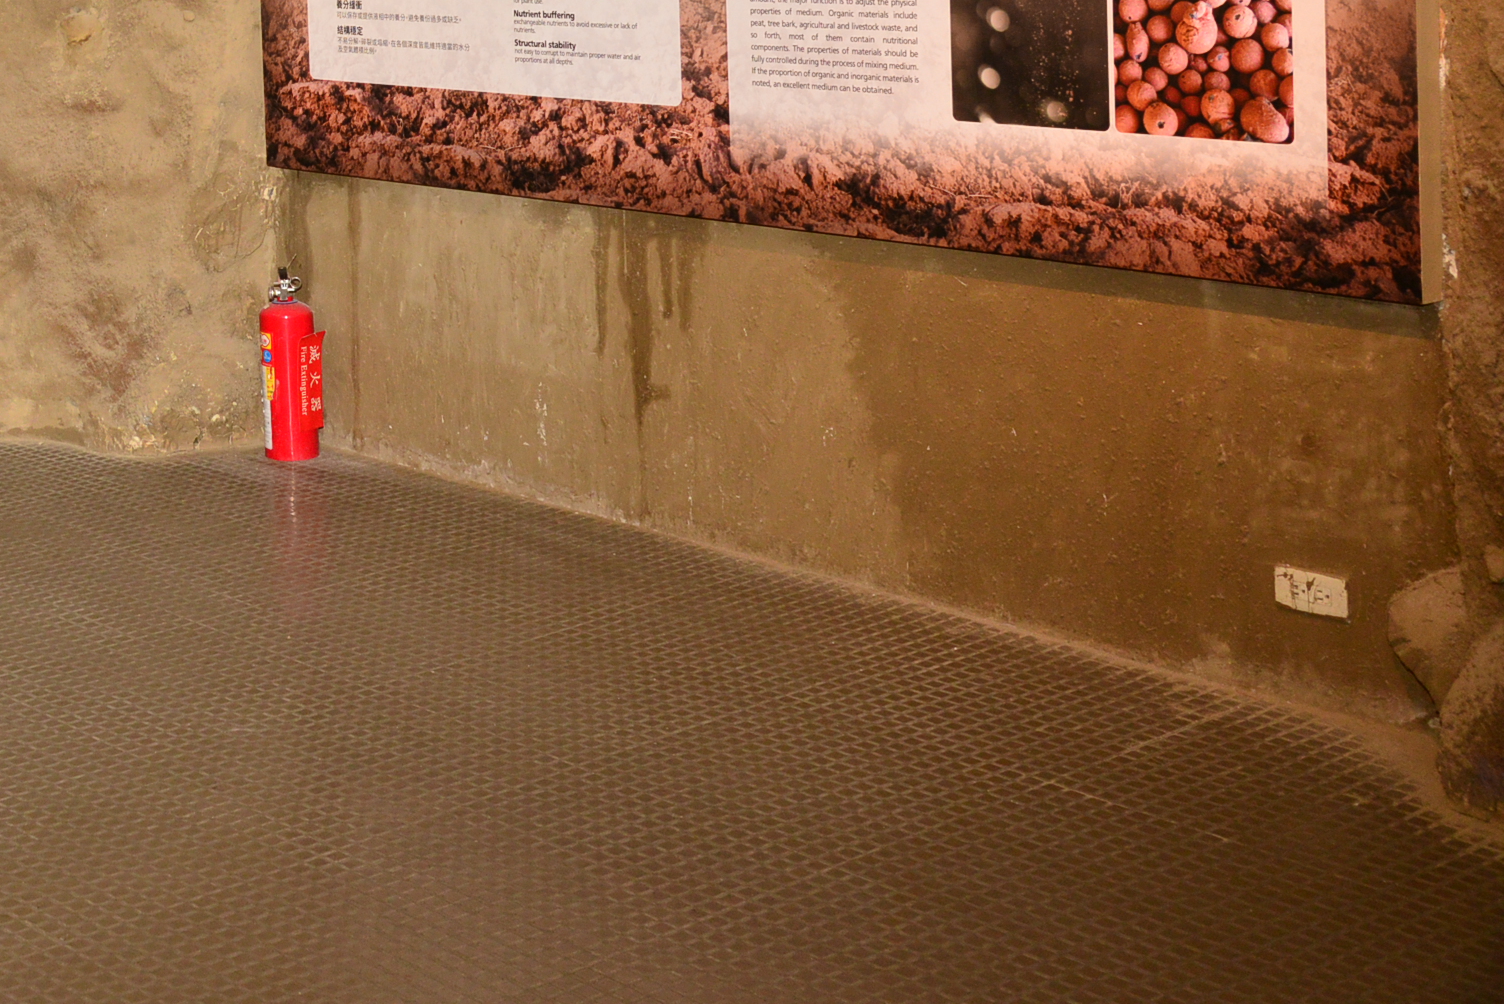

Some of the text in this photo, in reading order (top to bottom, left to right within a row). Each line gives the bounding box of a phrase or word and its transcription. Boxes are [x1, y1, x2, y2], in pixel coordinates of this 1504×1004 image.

[513, 10, 575, 21] Nutrient buffering
[750, 8, 918, 20] properties of medium. Organic materials include
[750, 20, 918, 33] peat, tree bark, agricultural and livestock waste, and
[514, 39, 576, 51] Structural stability
[300, 346, 308, 416] Fire Extinguisher
